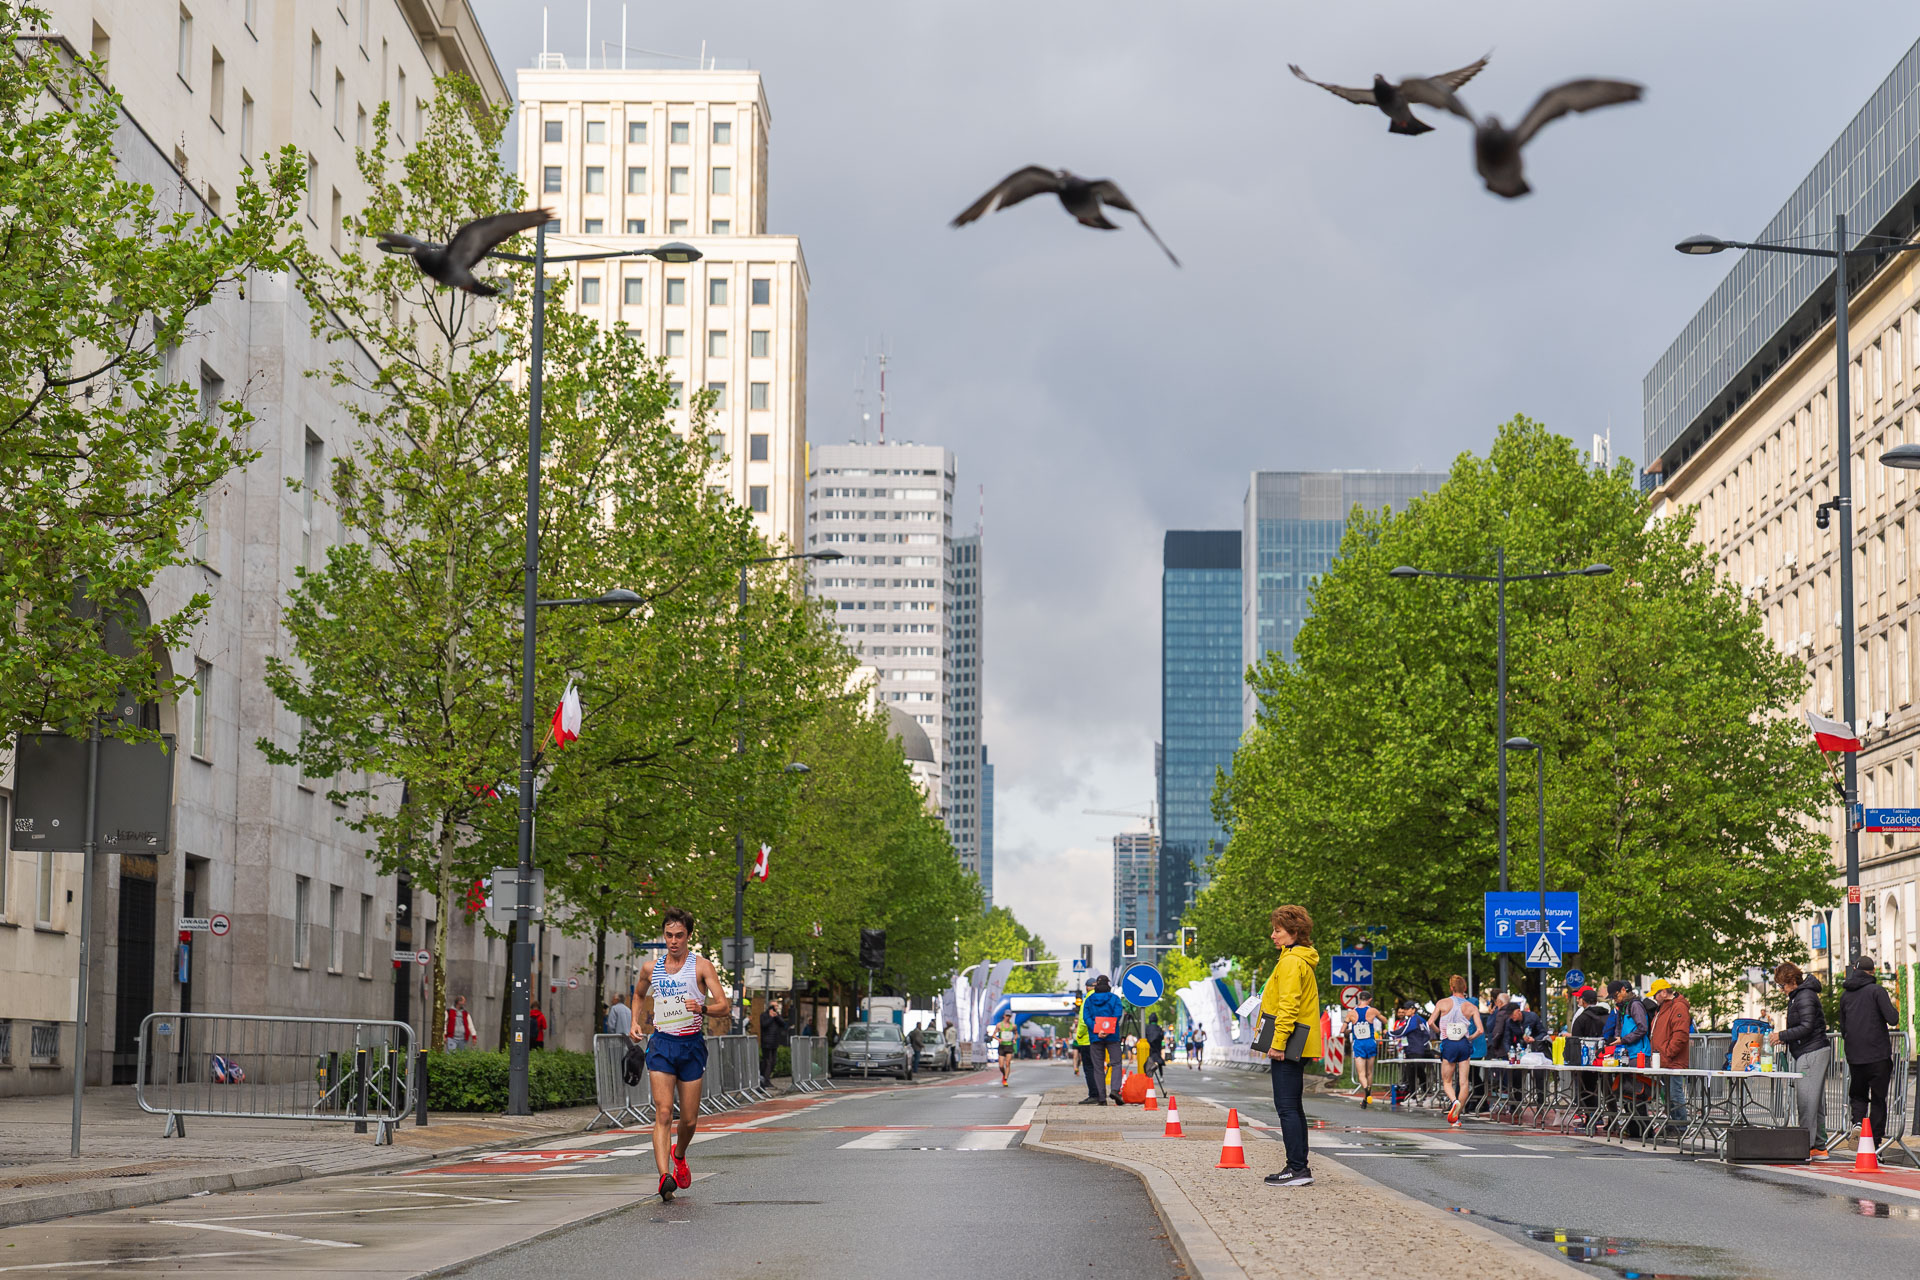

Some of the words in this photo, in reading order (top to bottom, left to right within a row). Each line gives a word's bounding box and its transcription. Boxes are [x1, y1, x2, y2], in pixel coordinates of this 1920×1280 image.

[659, 979, 677, 988] USA
[674, 995, 686, 1004] 36
[663, 1009, 683, 1018] LIMAS
[1452, 1027, 1462, 1035] 33
